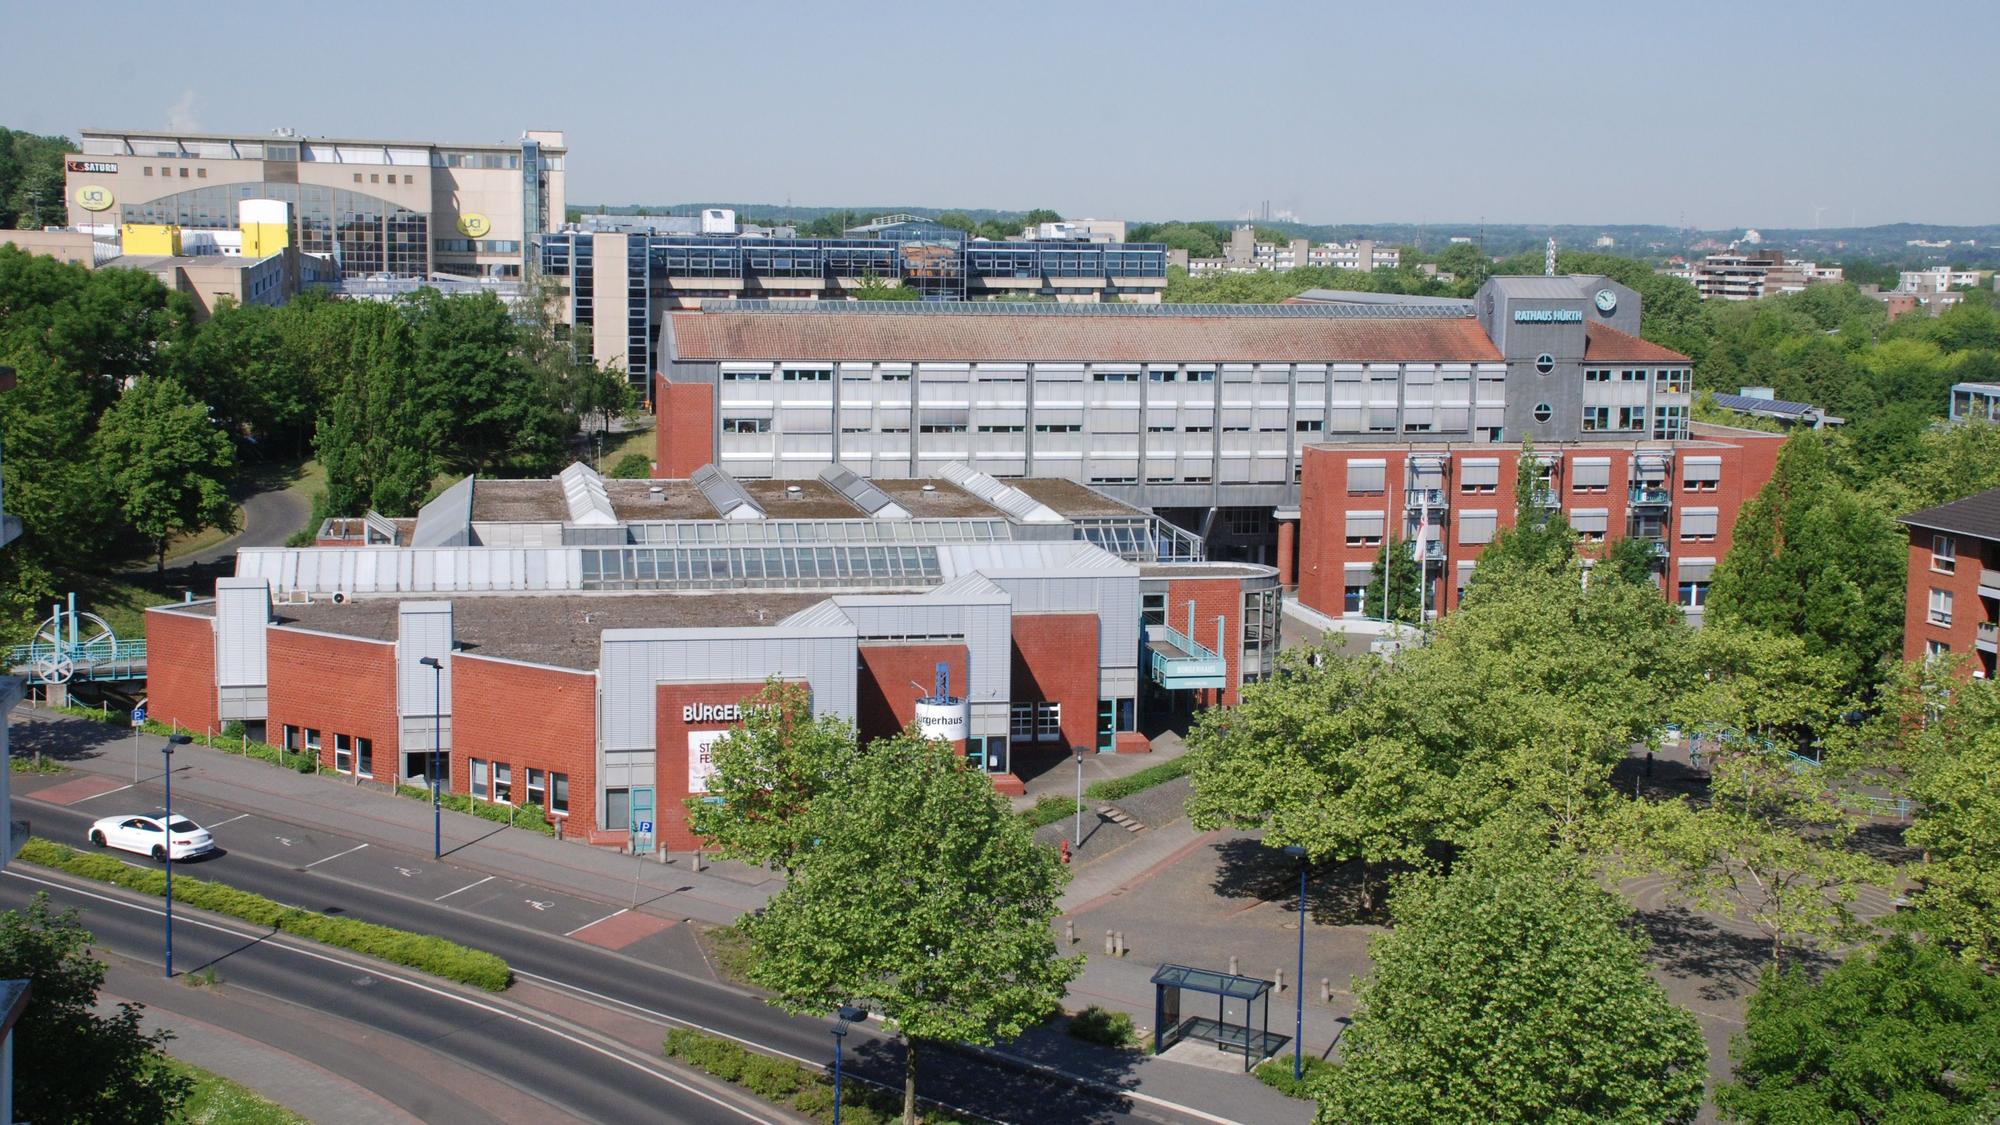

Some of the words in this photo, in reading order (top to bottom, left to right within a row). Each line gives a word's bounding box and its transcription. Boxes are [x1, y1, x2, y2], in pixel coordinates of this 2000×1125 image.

[84, 163, 117, 172] SATURN
[84, 191, 103, 201] UCI
[464, 218, 480, 228] UCI
[1514, 310, 1552, 321] RATHAUS
[1553, 309, 1582, 321] HÜRTH
